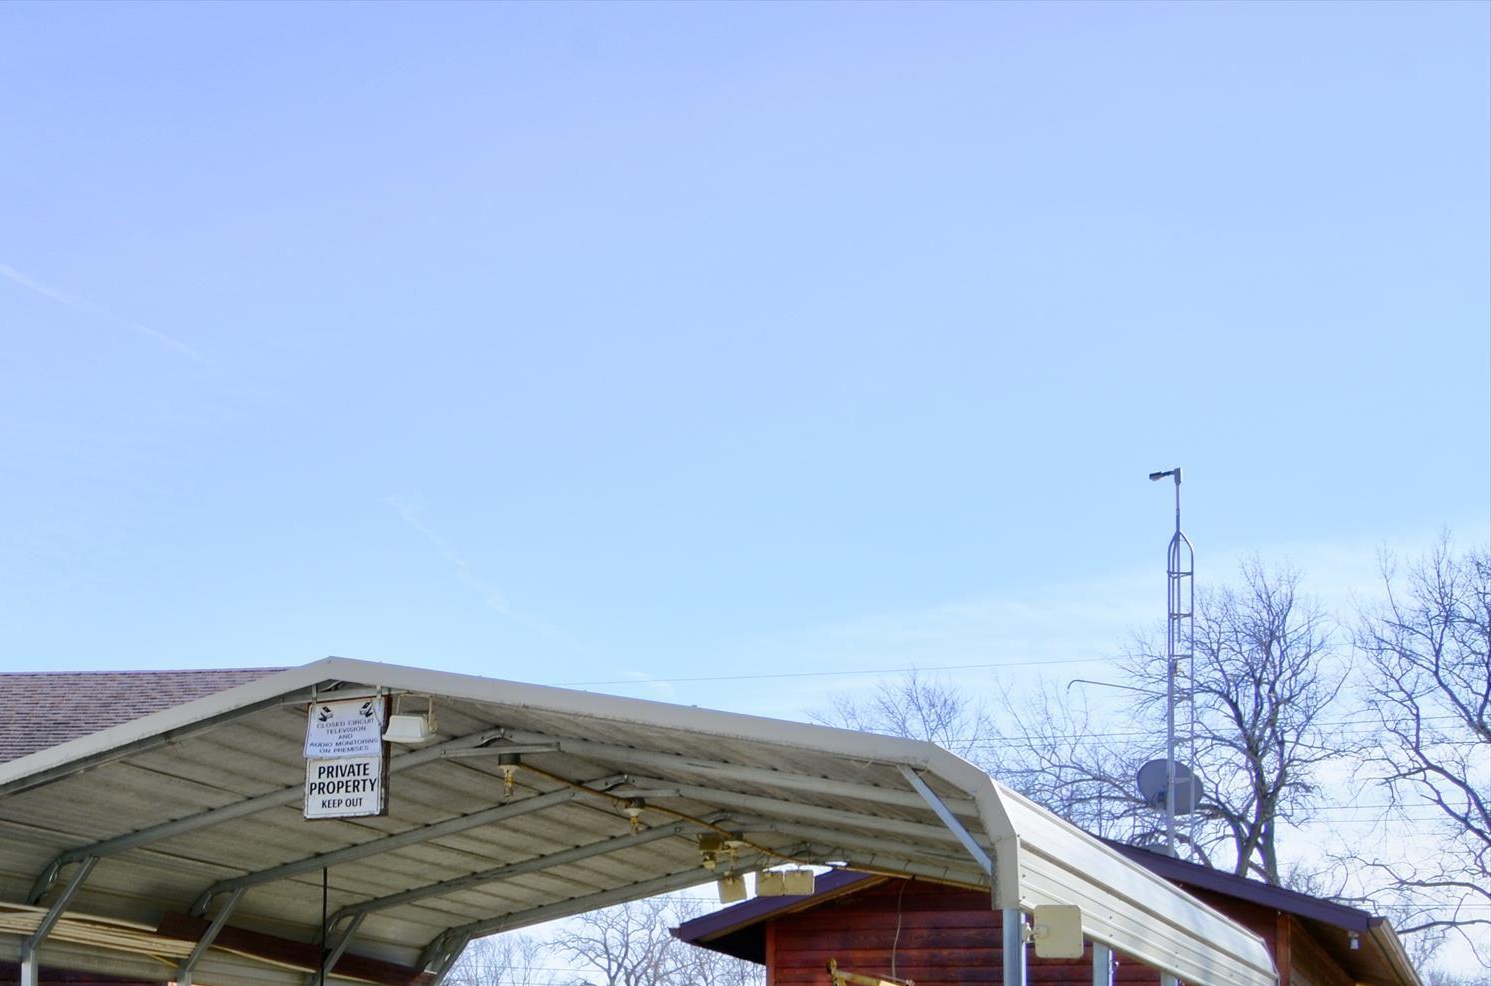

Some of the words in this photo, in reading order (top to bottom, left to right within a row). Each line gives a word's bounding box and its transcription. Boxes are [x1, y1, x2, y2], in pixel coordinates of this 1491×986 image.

[316, 720, 345, 729] CLOSED
[326, 725, 367, 735] TELEVISION
[335, 737, 379, 746] MONITORING
[317, 762, 370, 779] PRIVATE
[309, 778, 377, 795] PROPERTY
[321, 798, 343, 809] KEEP
[345, 797, 364, 808] OUT
